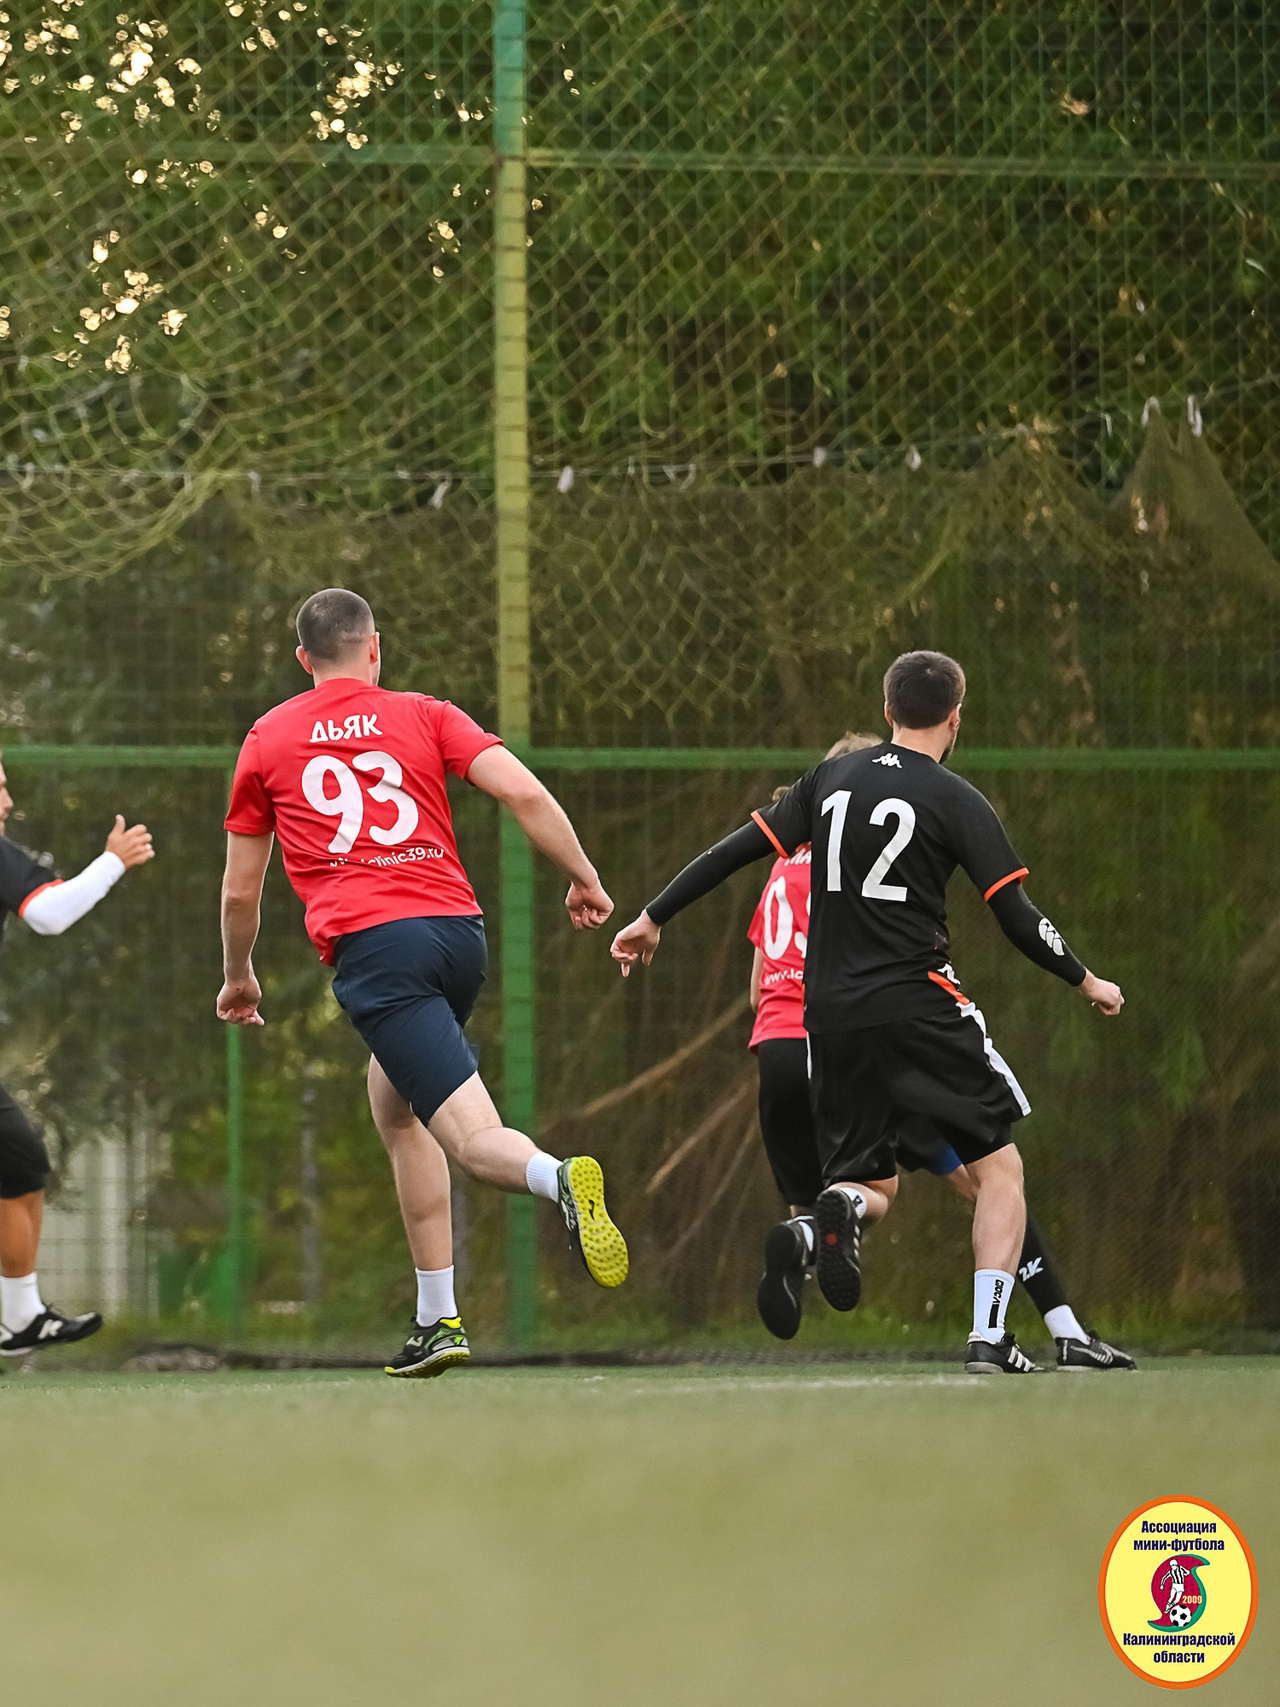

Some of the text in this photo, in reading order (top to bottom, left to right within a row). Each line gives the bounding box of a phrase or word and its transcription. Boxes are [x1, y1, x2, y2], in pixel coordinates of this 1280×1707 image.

[309, 713, 383, 743] ДЬЯК
[301, 751, 419, 854] 93
[821, 789, 917, 902] 12
